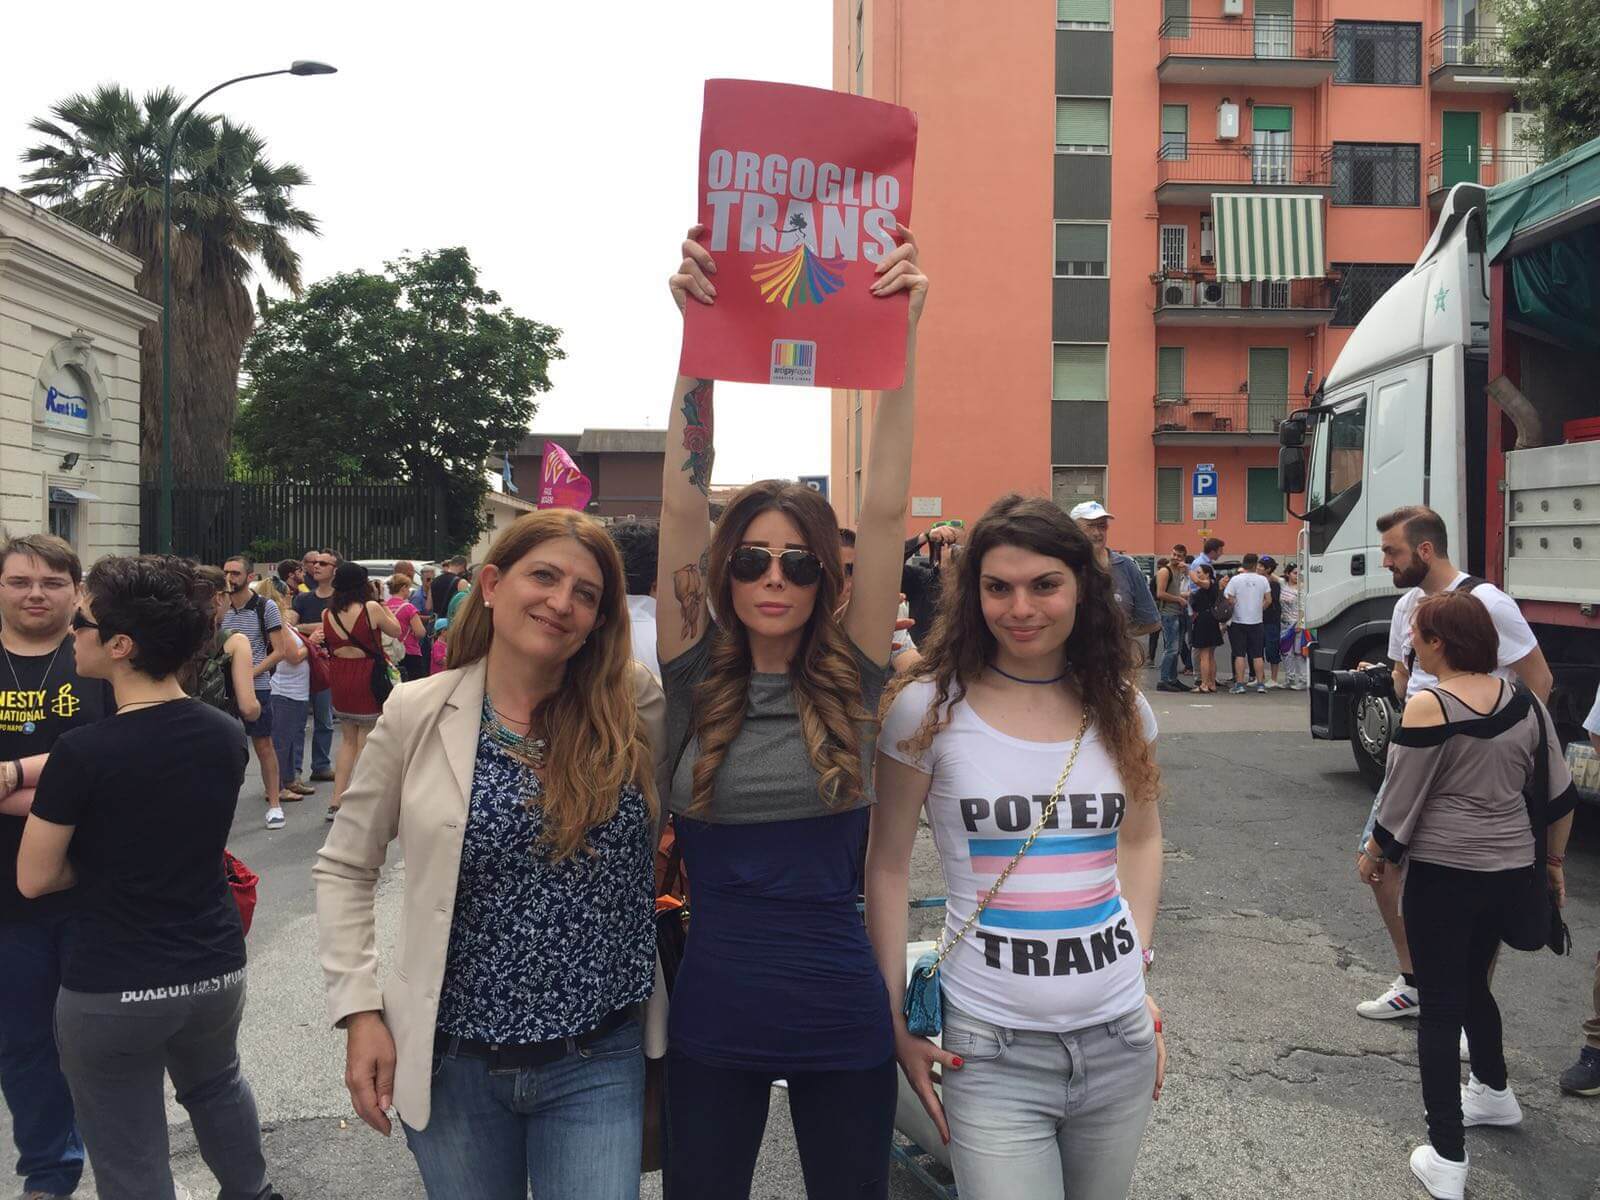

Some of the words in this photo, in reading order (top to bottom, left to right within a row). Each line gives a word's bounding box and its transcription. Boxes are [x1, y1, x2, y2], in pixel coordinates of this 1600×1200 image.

[708, 149, 899, 211] ORGOGLIO
[706, 190, 897, 264] TRANS
[1198, 475, 1213, 494] P
[960, 793, 1126, 832] POTER
[975, 917, 1135, 977] TRANS
